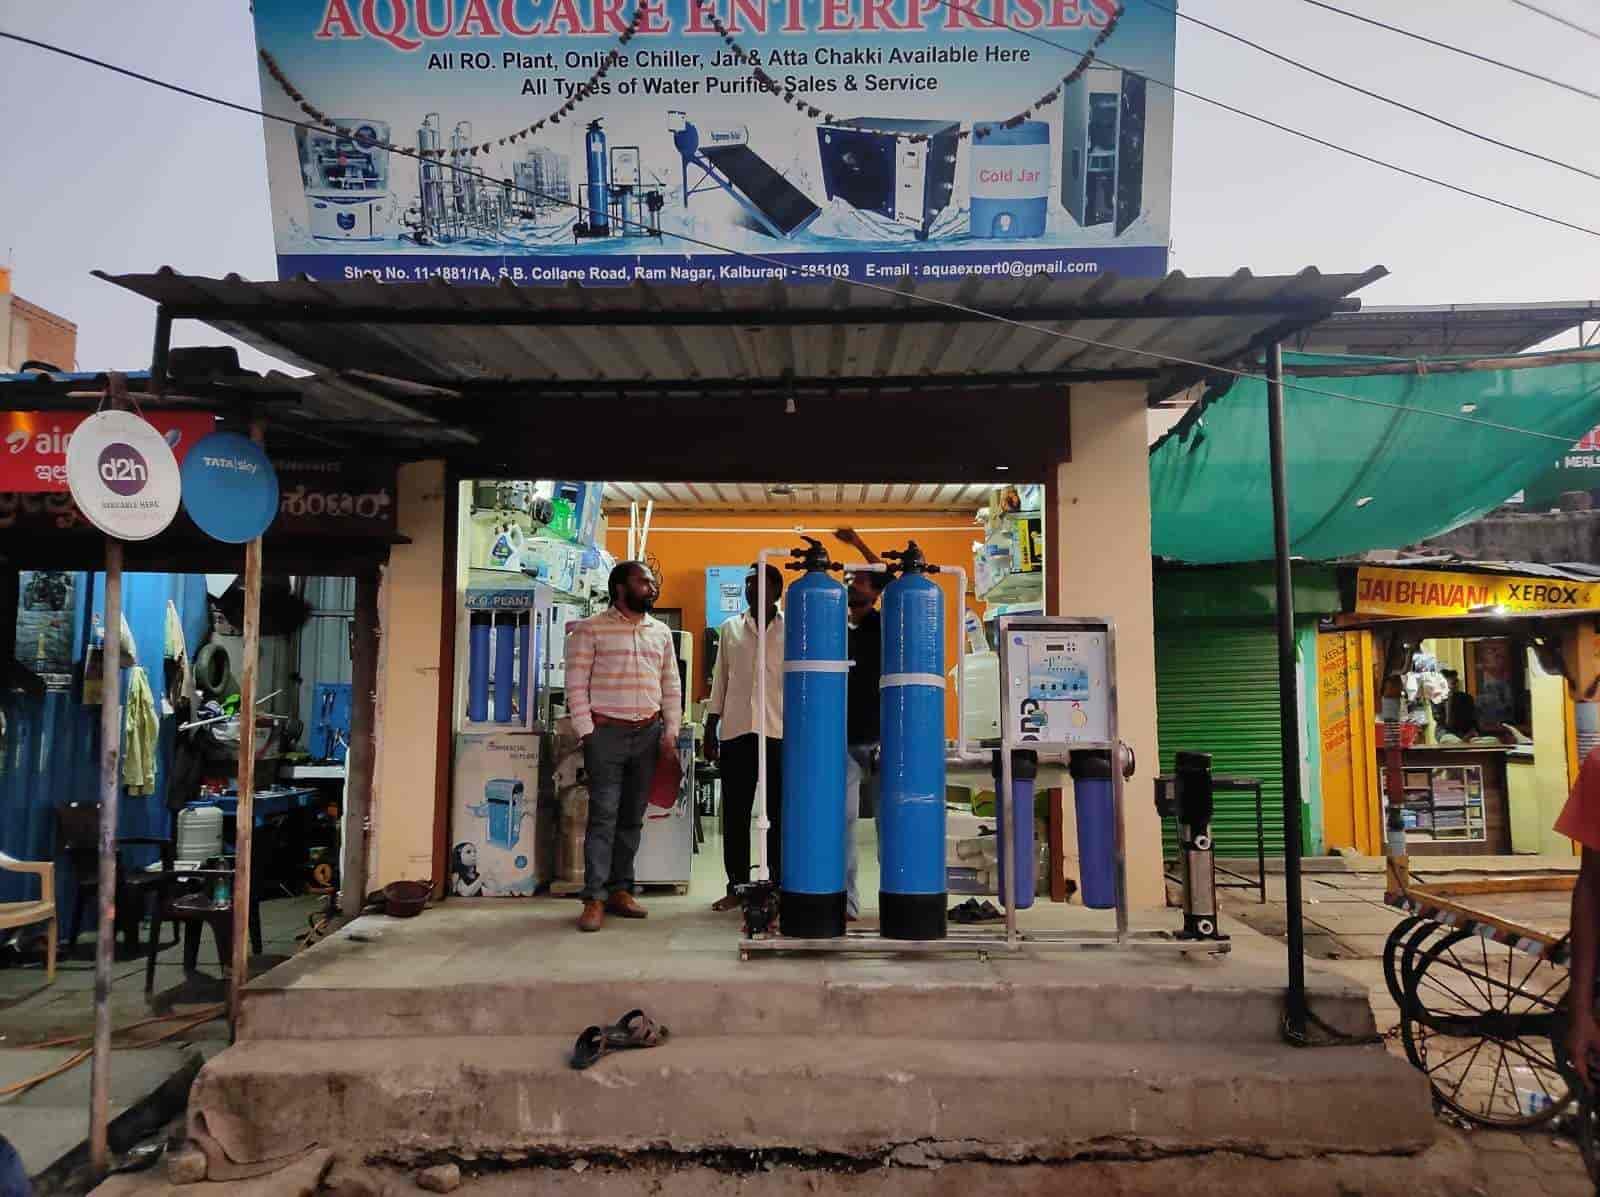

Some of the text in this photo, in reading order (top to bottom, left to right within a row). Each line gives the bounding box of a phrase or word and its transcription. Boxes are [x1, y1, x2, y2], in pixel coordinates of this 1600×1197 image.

[315, 0, 1119, 50] AQUACARE ENTERPRISES
[428, 46, 1031, 70] All RO. Plant, Online Chiller, Jar & Atta Chakki Available Here
[521, 73, 938, 99] All Types of Water Purifier Sales & Service
[980, 168, 1041, 183] Cold Jar
[386, 267, 410, 280] No.
[532, 266, 586, 281] Collage
[590, 266, 631, 281] Road,
[635, 266, 666, 280] Ram
[671, 266, 716, 281] Nagar,
[866, 263, 910, 277] E-mail
[35, 426, 73, 454] air
[101, 458, 146, 481] d2h
[1359, 578, 1392, 601] JAI
[1395, 579, 1489, 609] BHAVANI
[1508, 583, 1579, 604] XEROX
